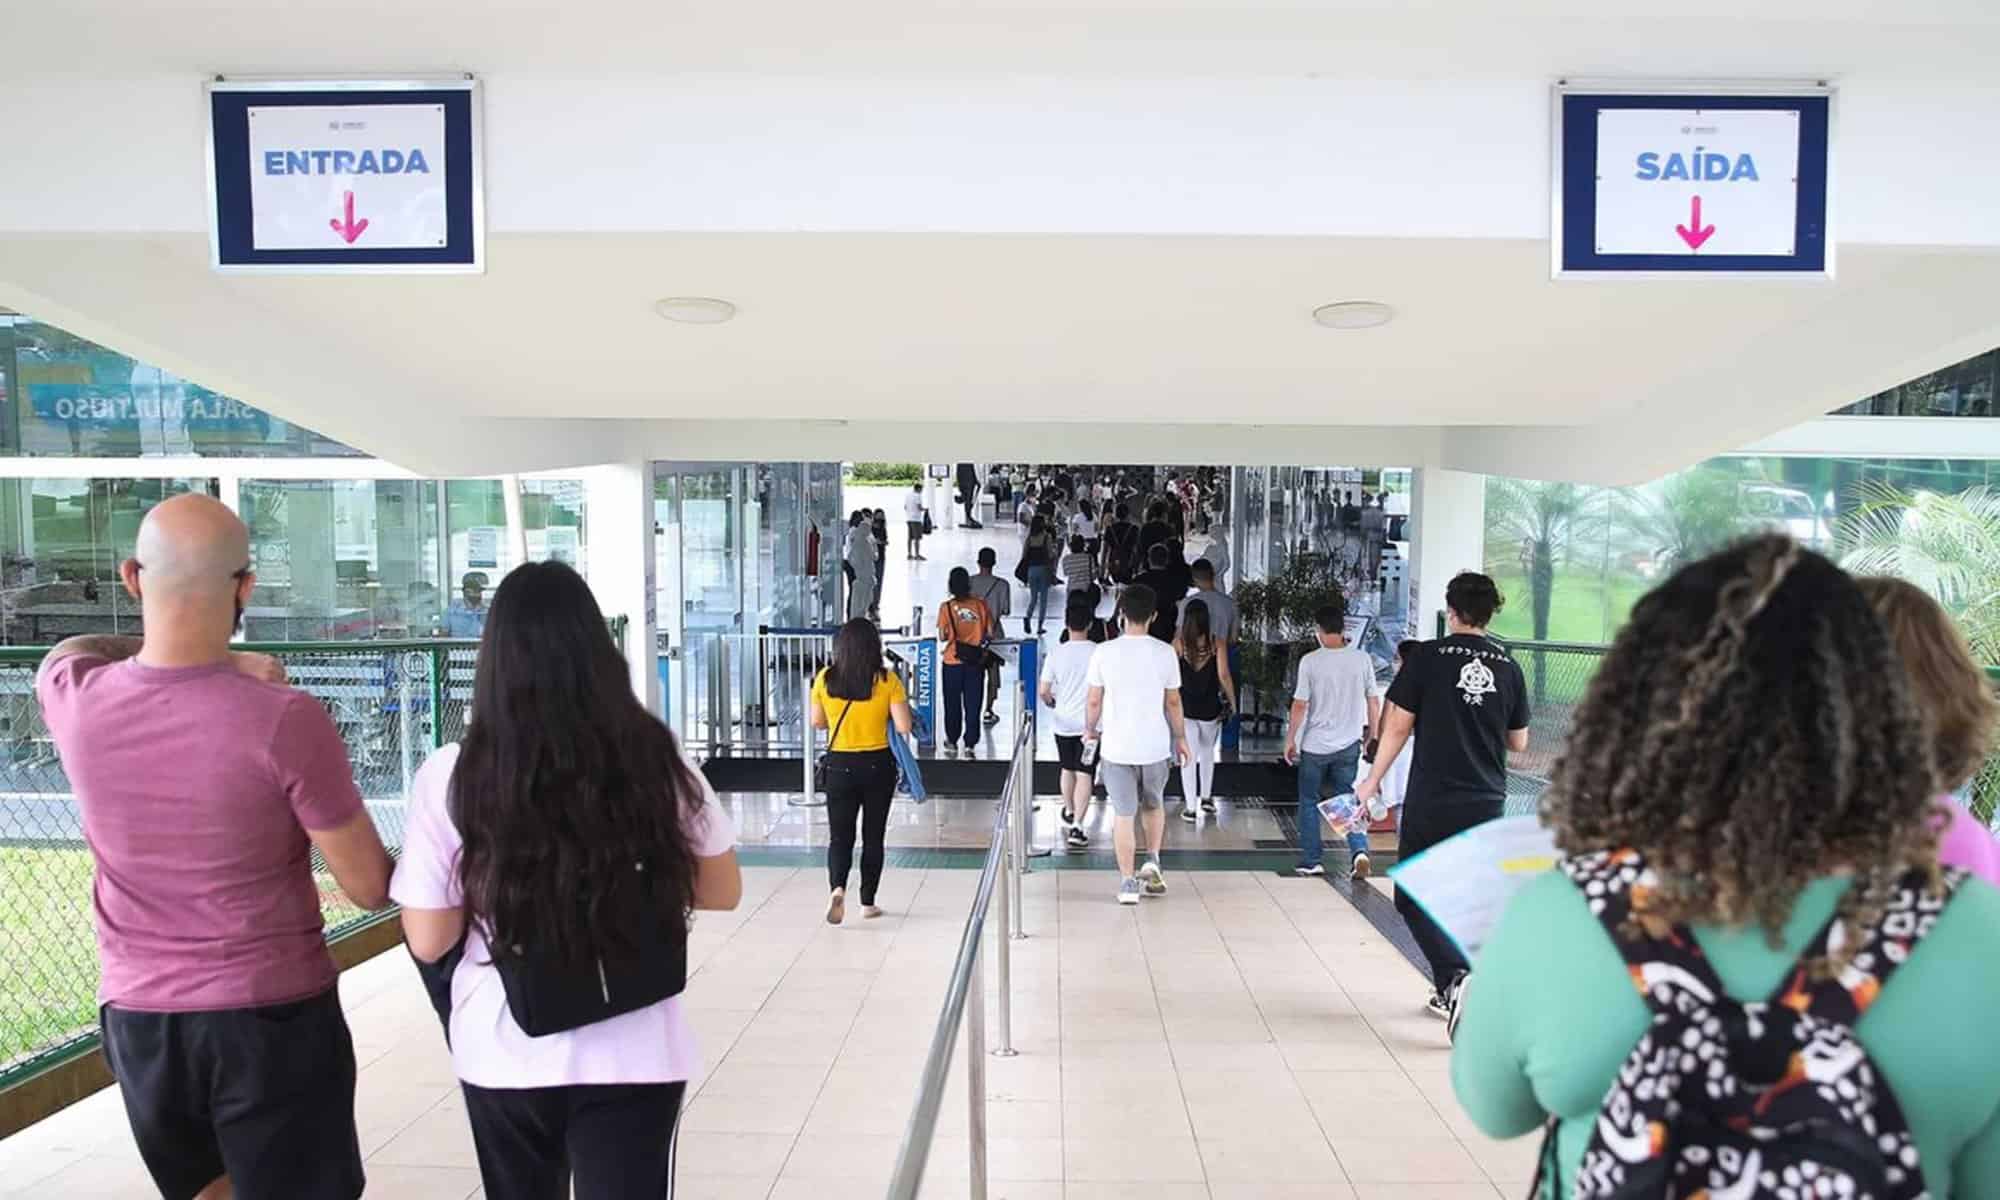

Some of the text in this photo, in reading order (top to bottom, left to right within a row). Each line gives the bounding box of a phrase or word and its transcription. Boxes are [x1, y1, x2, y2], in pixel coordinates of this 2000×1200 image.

[264, 149, 430, 176] ENTRADA
[1635, 146, 1760, 181] SAÍDA
[920, 647, 930, 706] ENTRADA
